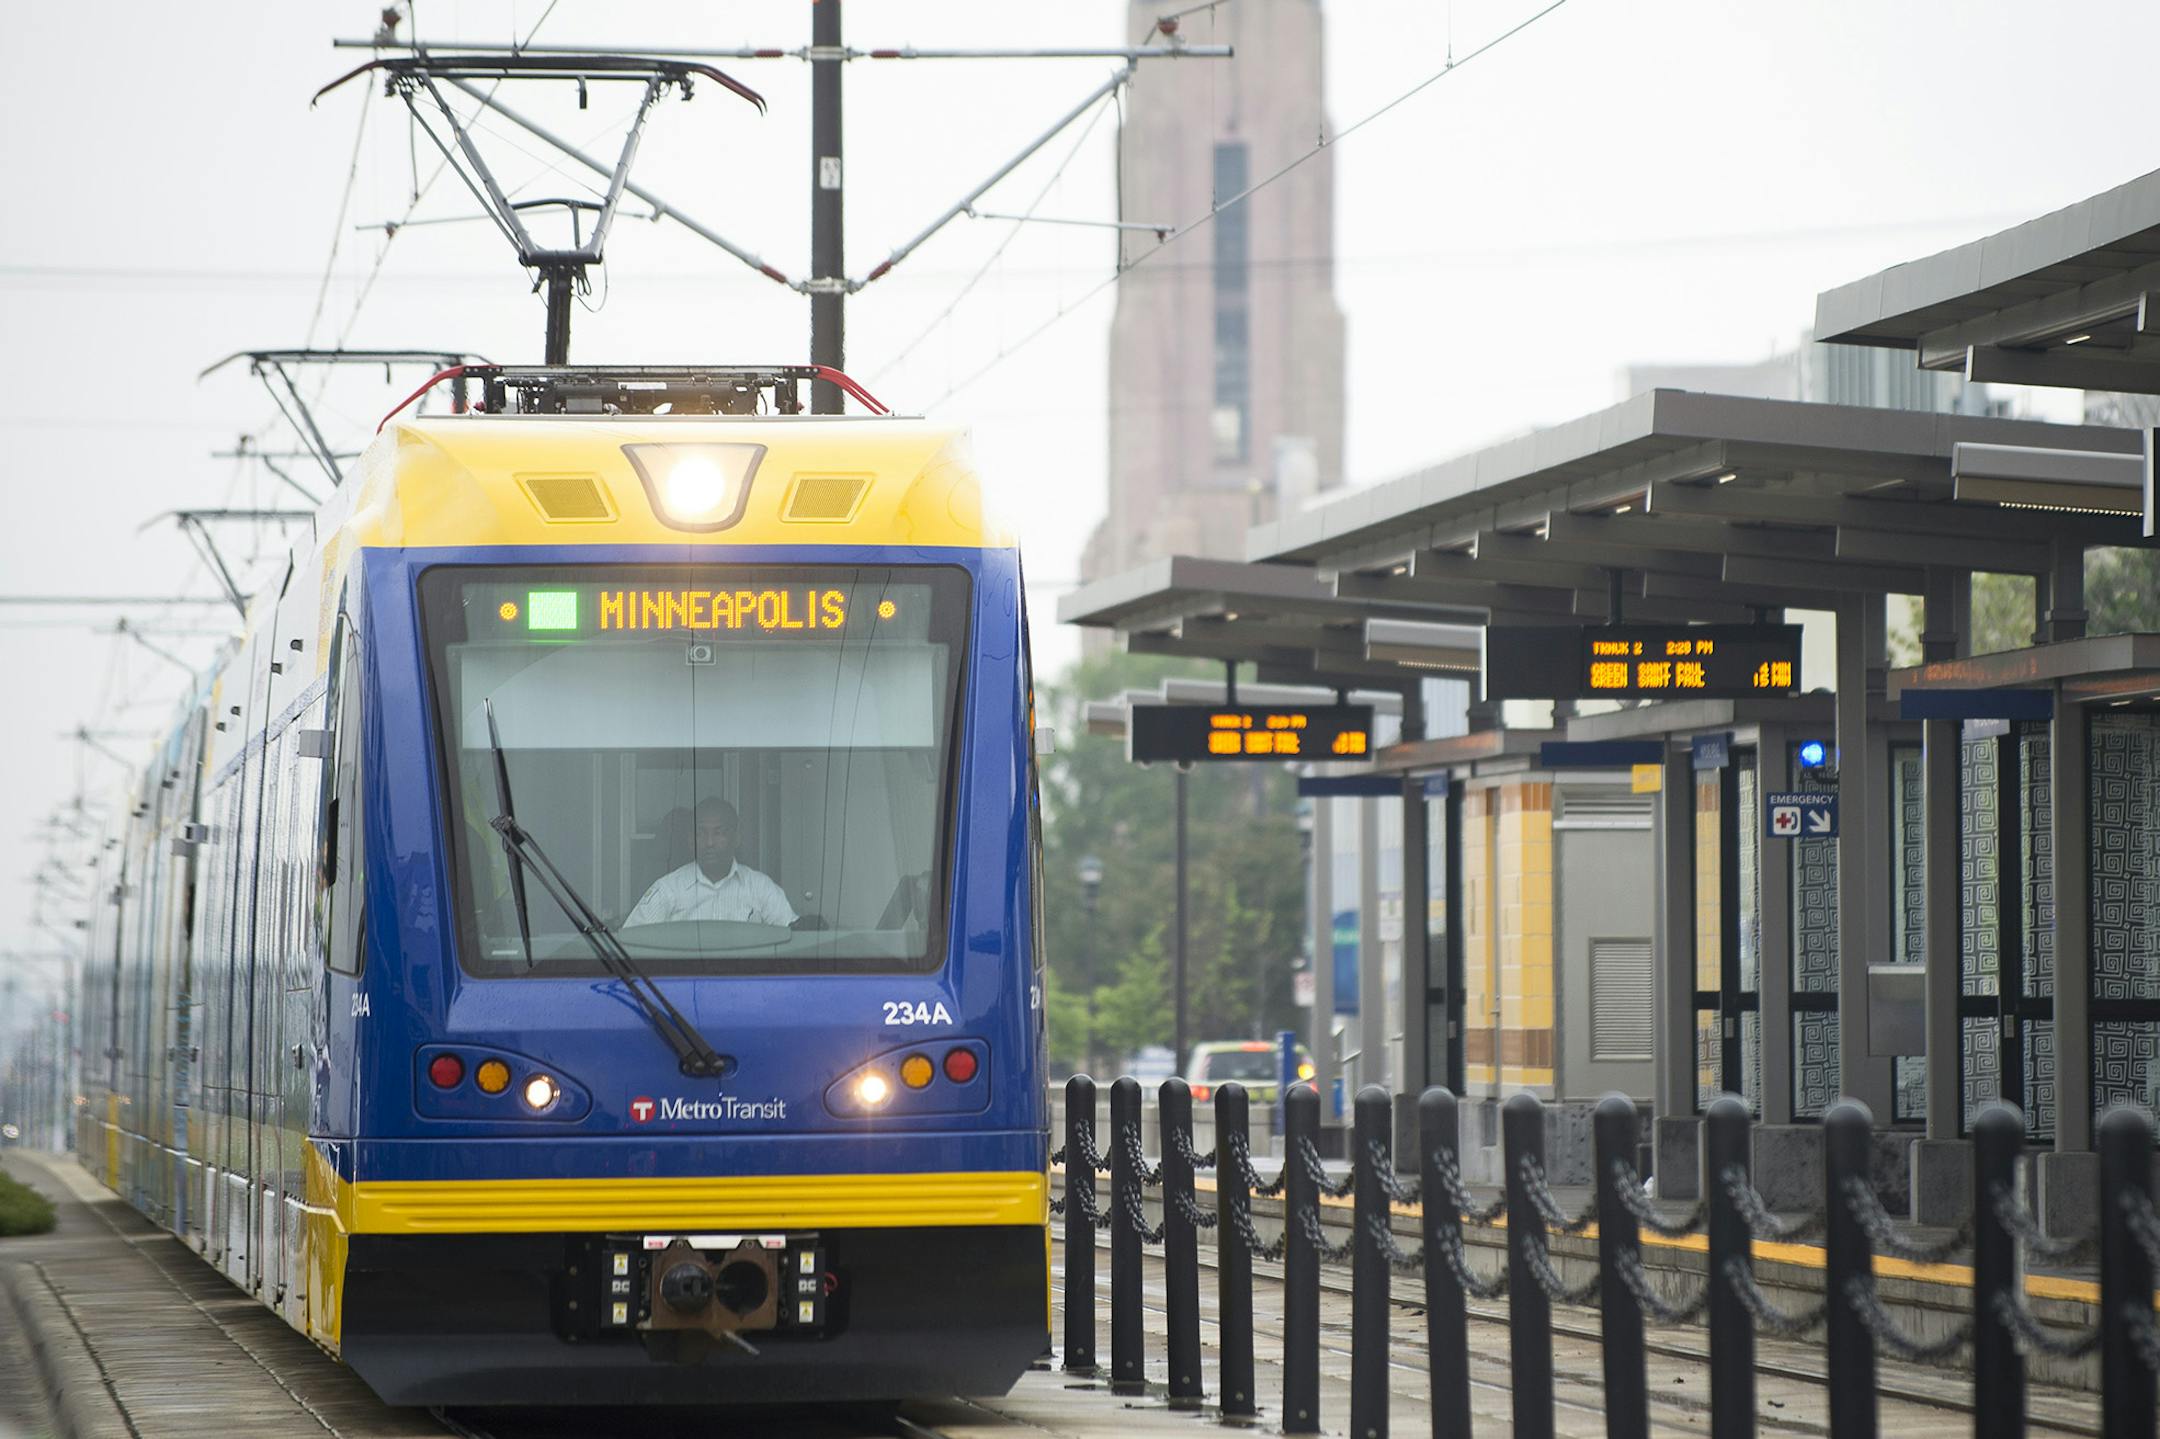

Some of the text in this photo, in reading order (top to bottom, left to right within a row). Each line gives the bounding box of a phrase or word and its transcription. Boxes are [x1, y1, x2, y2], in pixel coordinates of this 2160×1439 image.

[600, 589, 845, 630] MINNEAPOLIS
[1632, 641, 1643, 656] 2
[1695, 639, 1714, 655] PM
[1770, 794, 1834, 805] EMERGENCY
[882, 1001, 953, 1026] 234A
